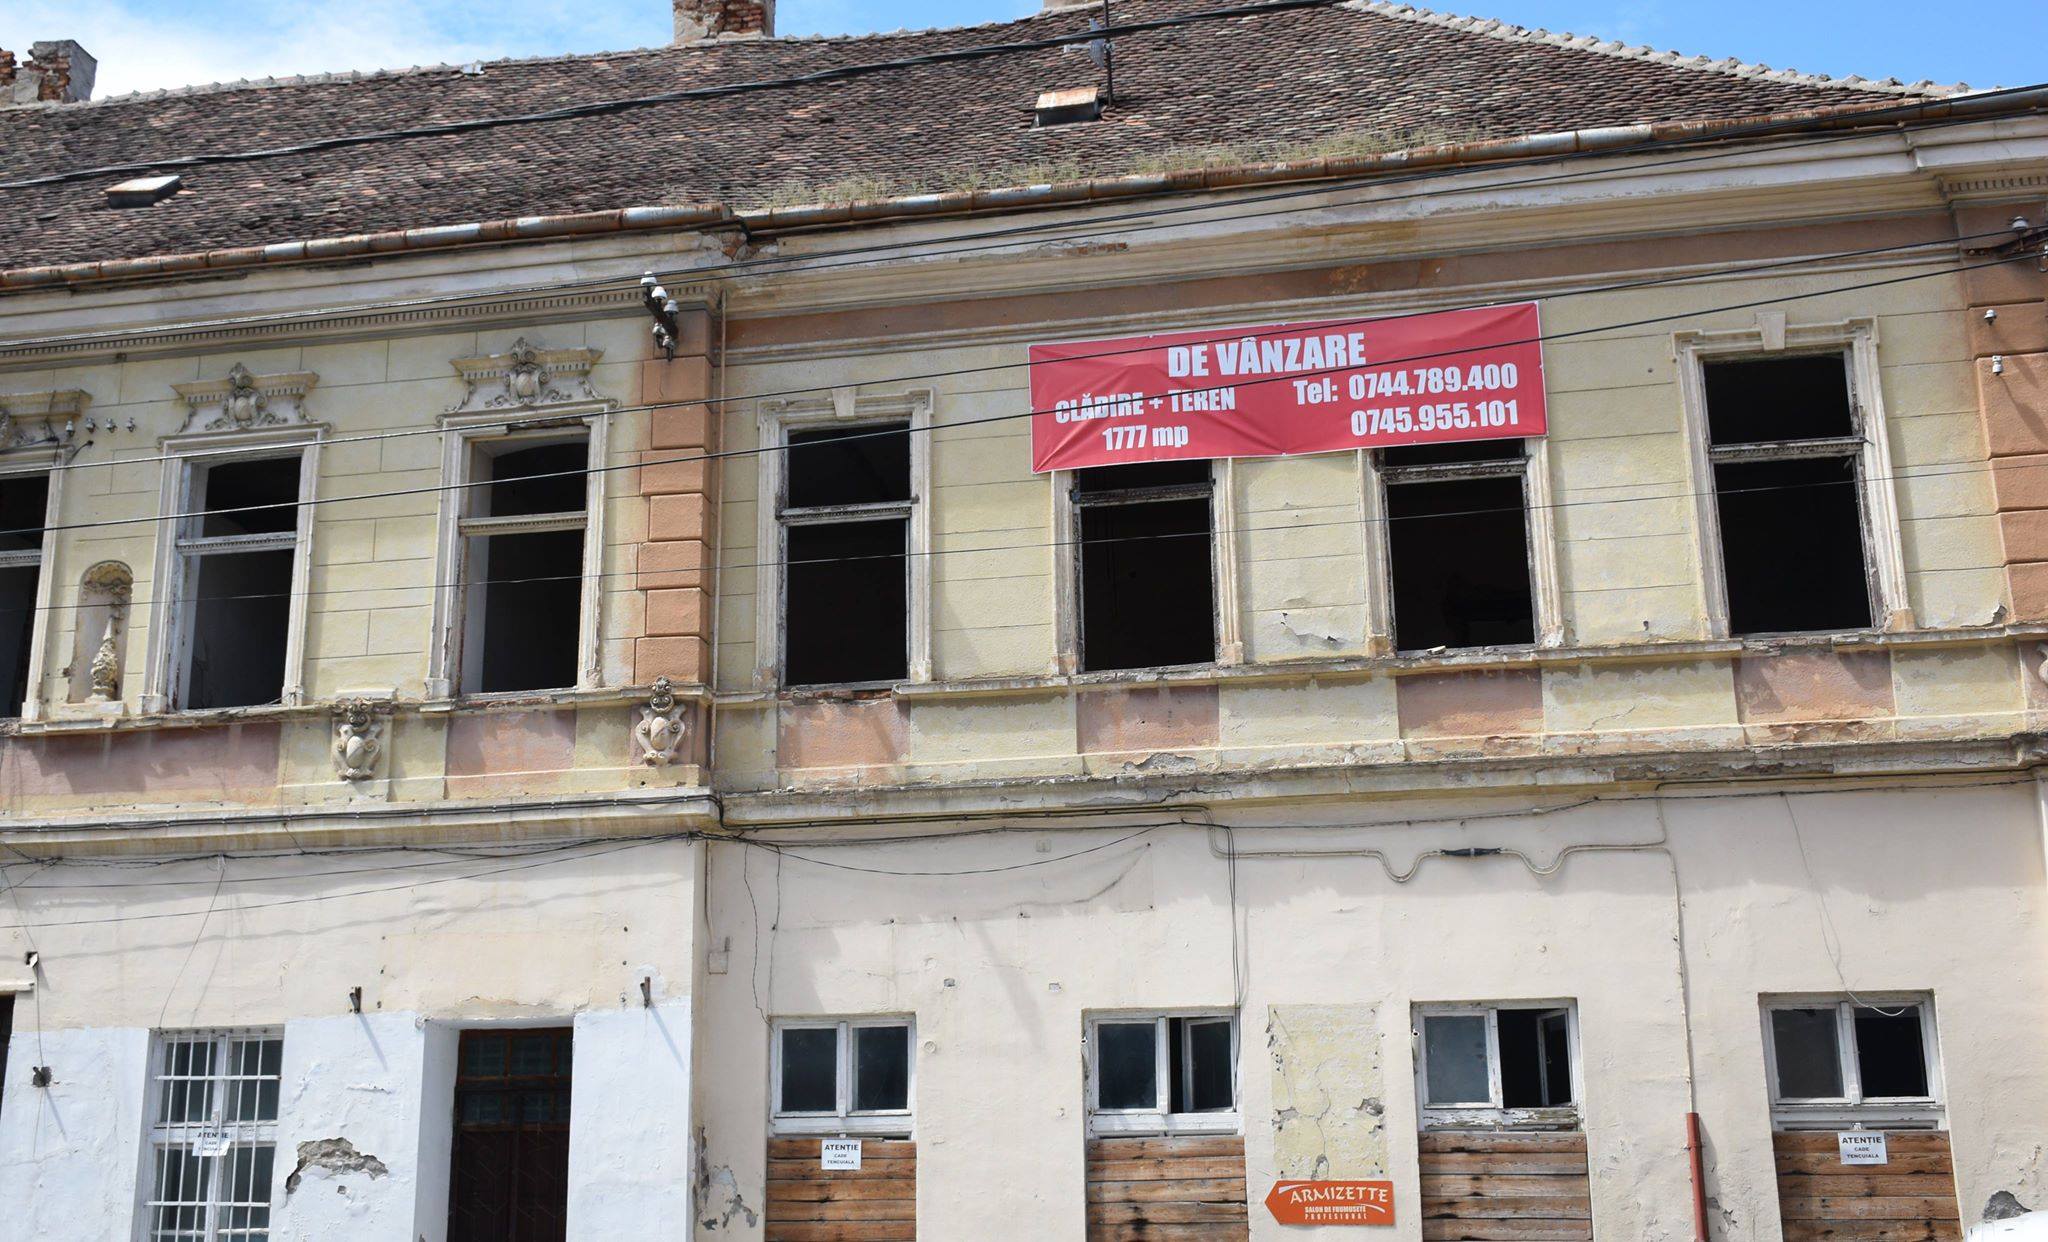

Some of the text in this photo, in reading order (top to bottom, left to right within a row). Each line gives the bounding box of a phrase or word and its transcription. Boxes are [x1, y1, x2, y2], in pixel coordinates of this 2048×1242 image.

[1168, 332, 1367, 378] DE VÂNZARE
[1293, 362, 1518, 405] Tel: 0744.789.400
[1055, 387, 1236, 424] CLĂDIRE + TEREN
[1351, 400, 1519, 436] 0745.955.101
[1102, 425, 1189, 451] 1777 mp
[1290, 1186, 1388, 1205] ARMIZETTE
